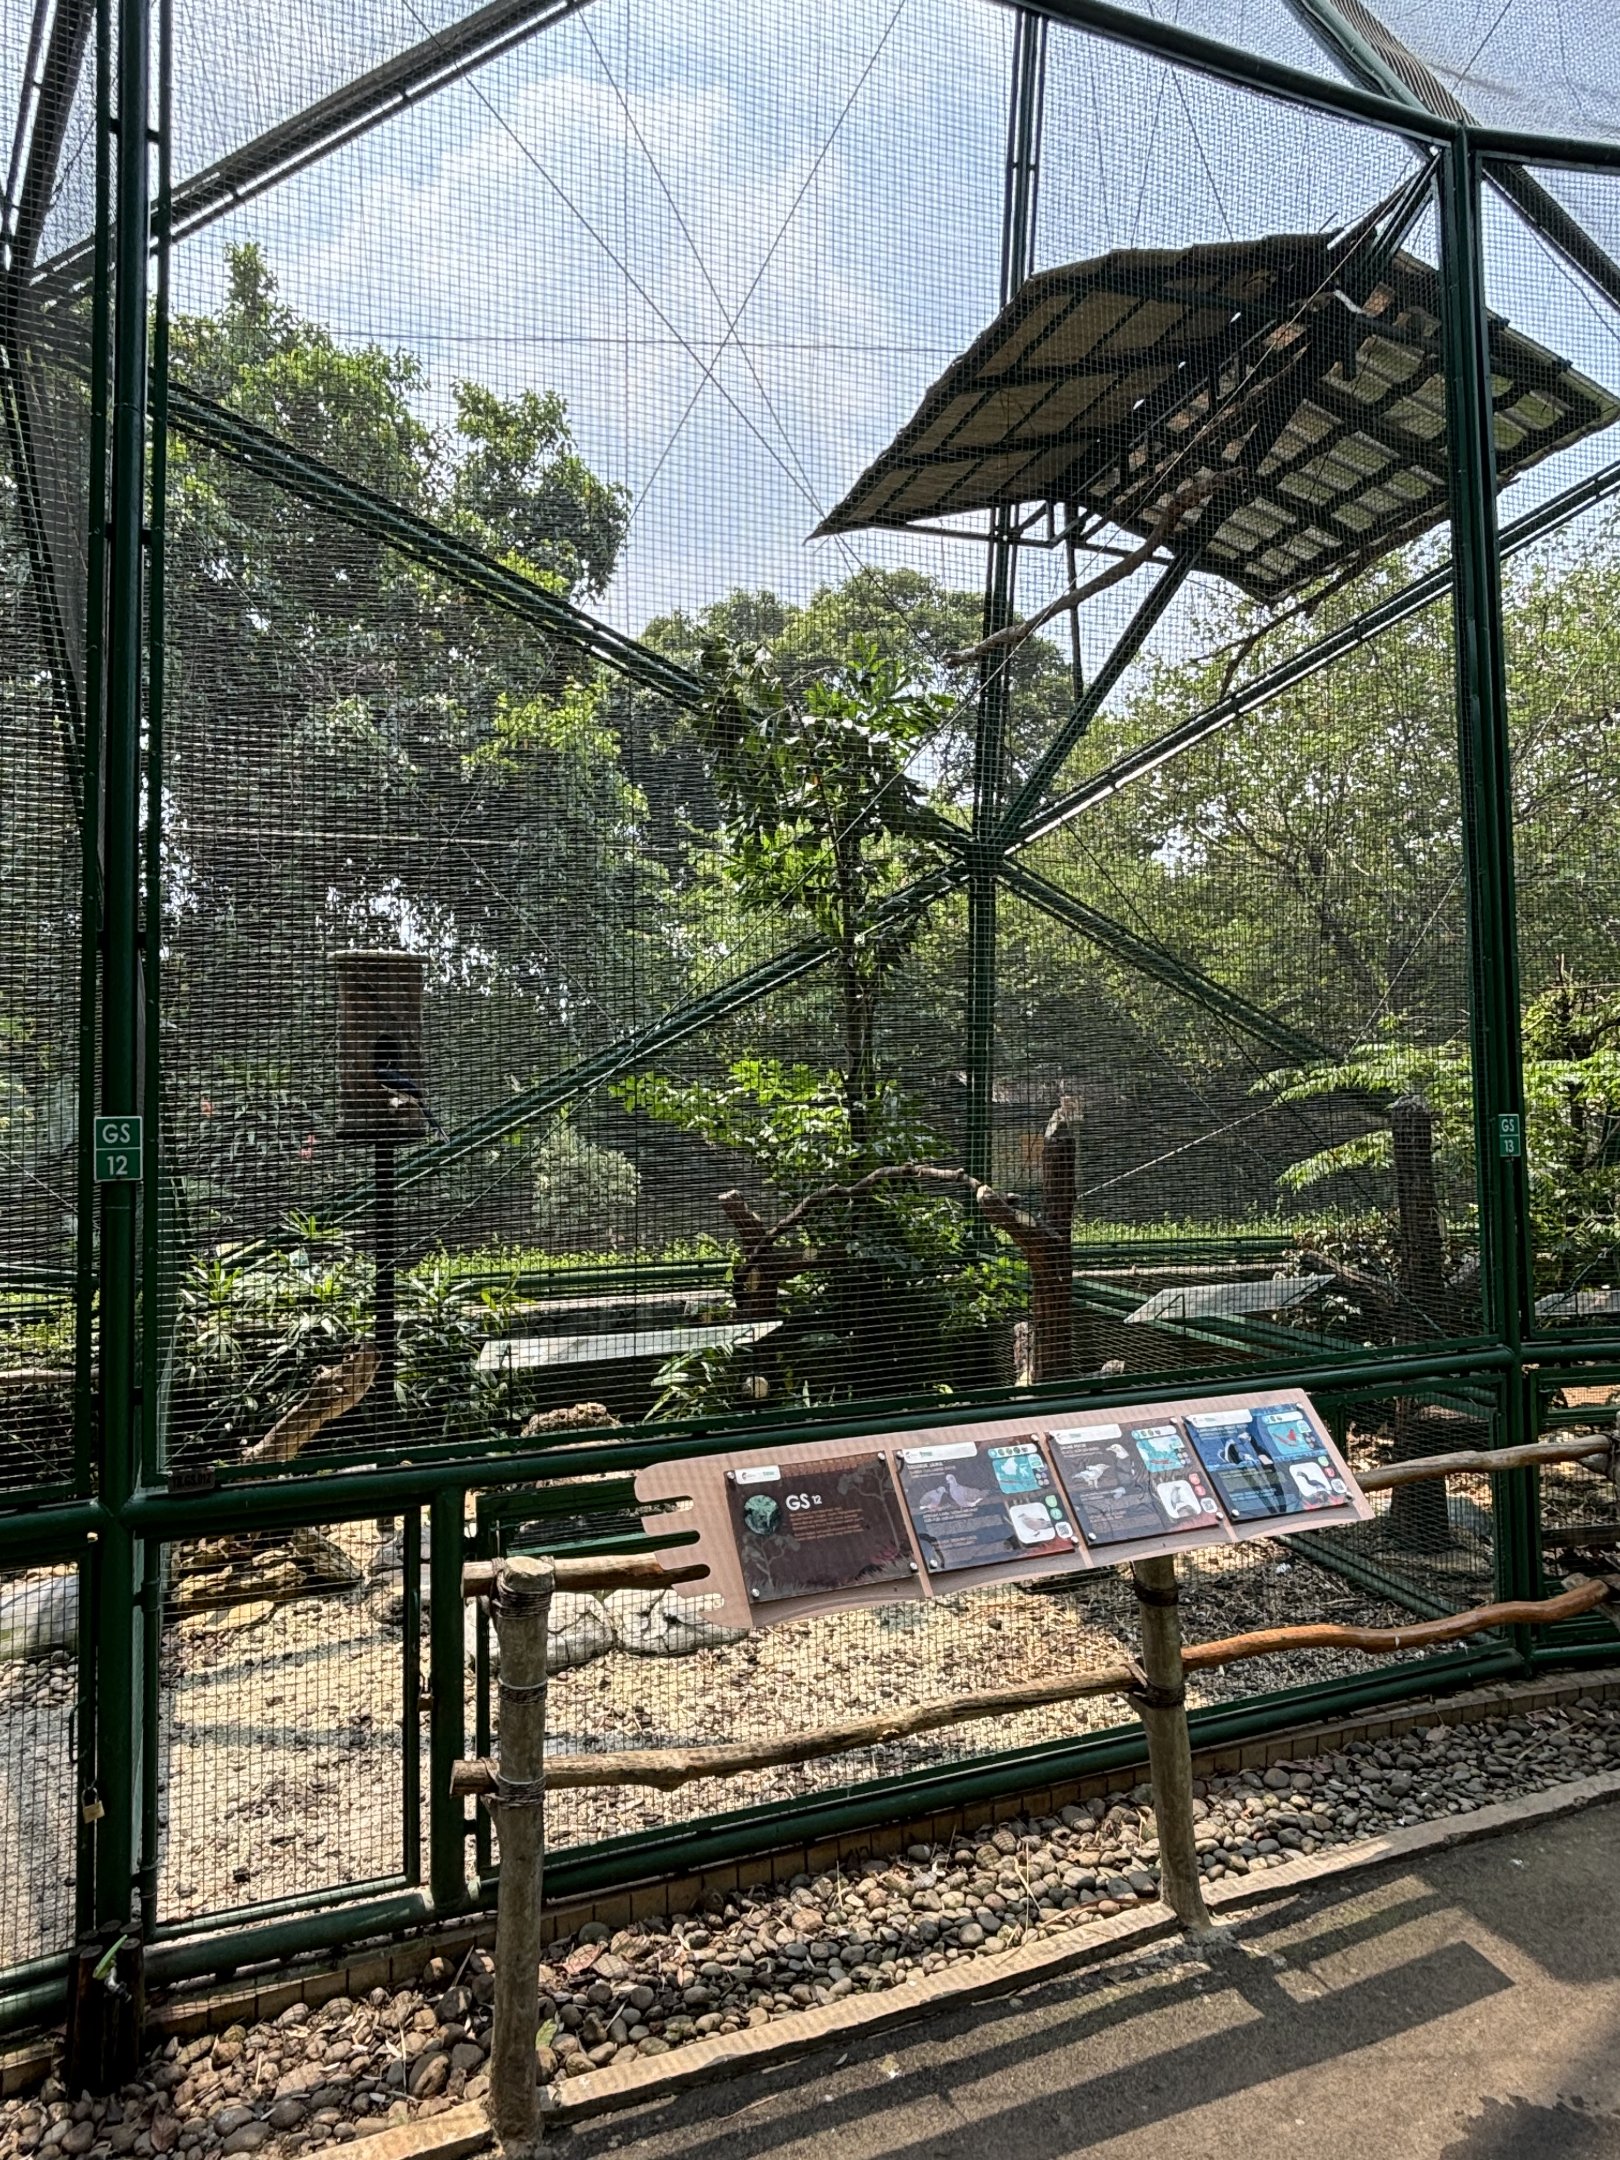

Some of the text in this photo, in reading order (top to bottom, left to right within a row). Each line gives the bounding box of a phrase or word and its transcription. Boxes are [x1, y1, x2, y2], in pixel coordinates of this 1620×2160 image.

[102, 1123, 130, 1144] GS
[1501, 1119, 1515, 1132] GS
[1504, 1139, 1514, 1153] 13
[106, 1155, 129, 1176] 12
[785, 1492, 823, 1511] GS 12
